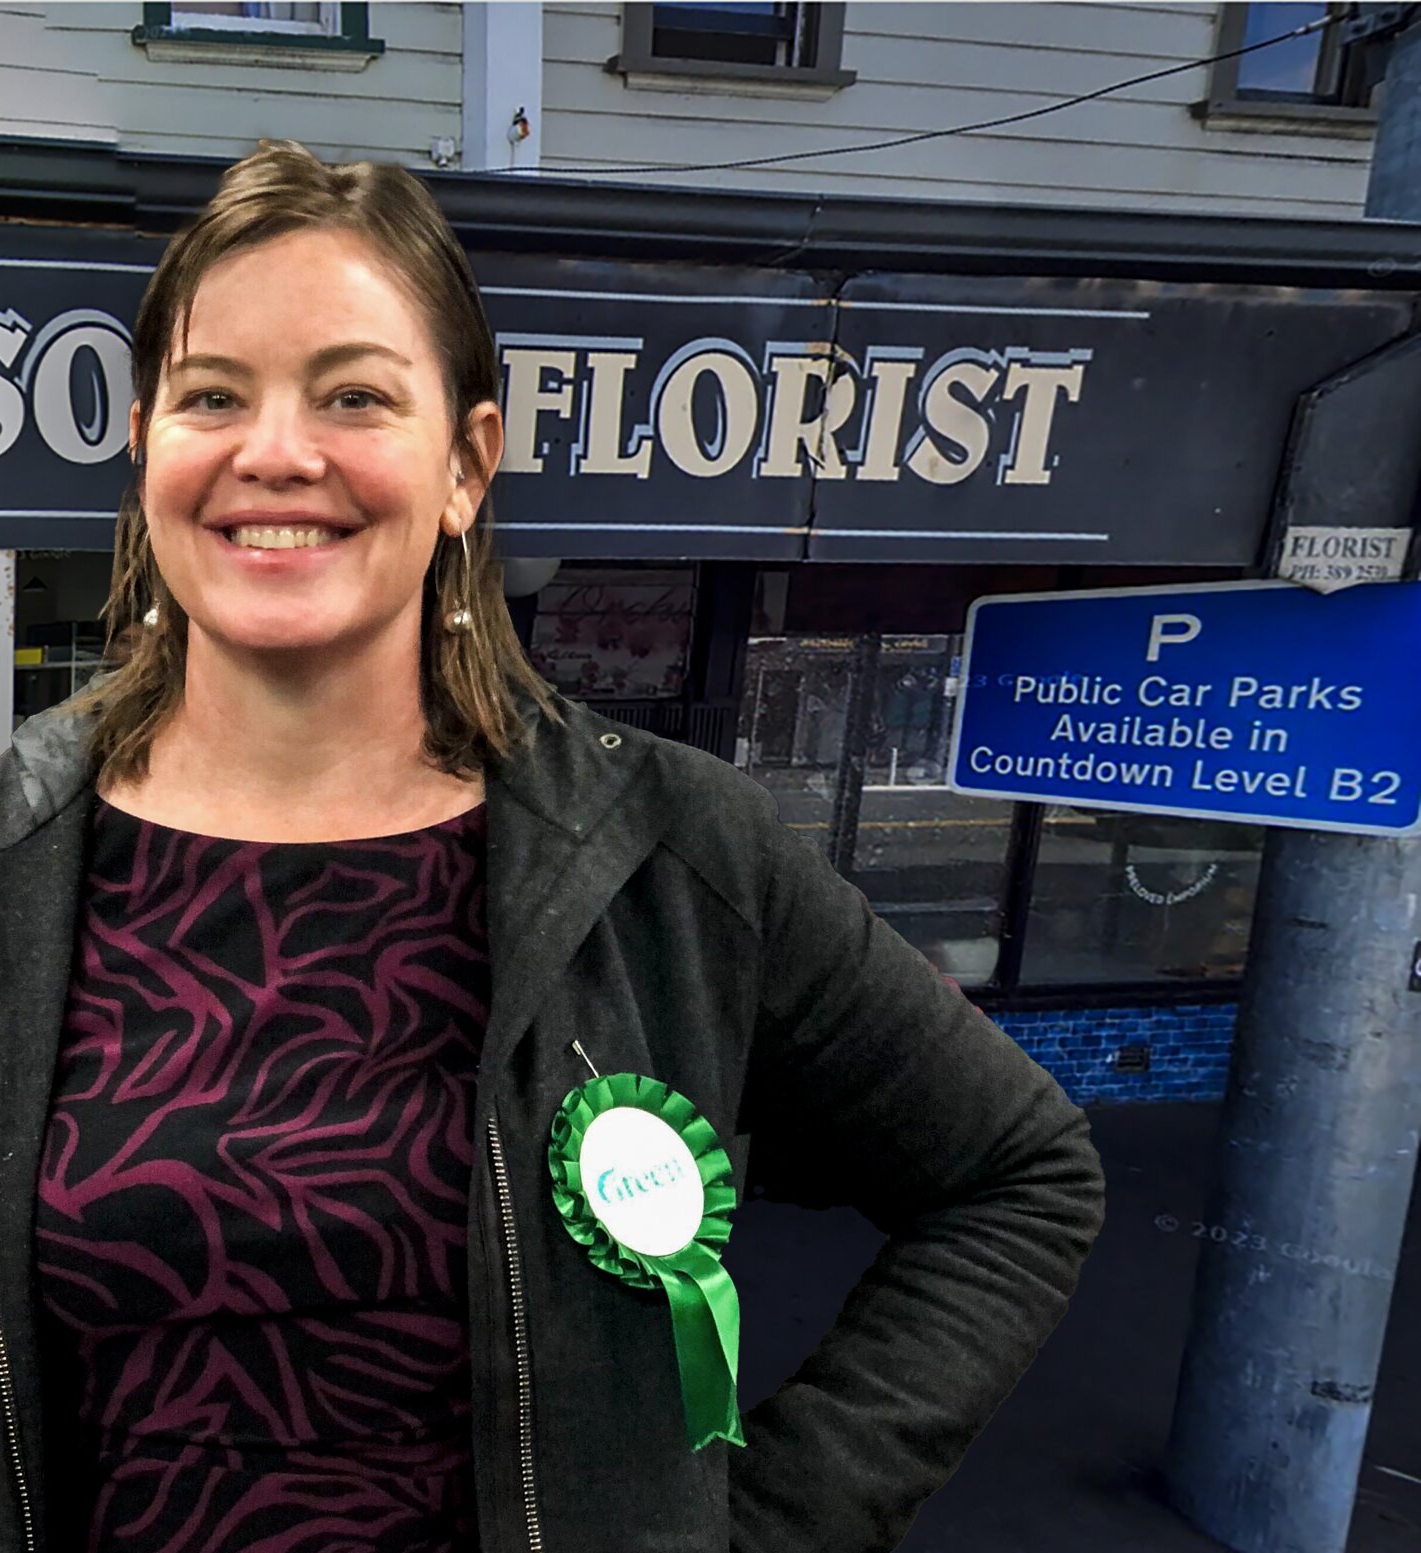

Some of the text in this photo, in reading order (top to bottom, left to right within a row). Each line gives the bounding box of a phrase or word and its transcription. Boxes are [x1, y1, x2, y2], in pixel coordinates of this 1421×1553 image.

[495, 333, 1092, 485] FLORIST
[1289, 535, 1397, 558] FLORIST
[1146, 613, 1202, 662] P
[1014, 676, 1363, 713] Public Car Parks
[1051, 714, 1288, 753] Available in
[970, 746, 1401, 805] Countdown Level B2
